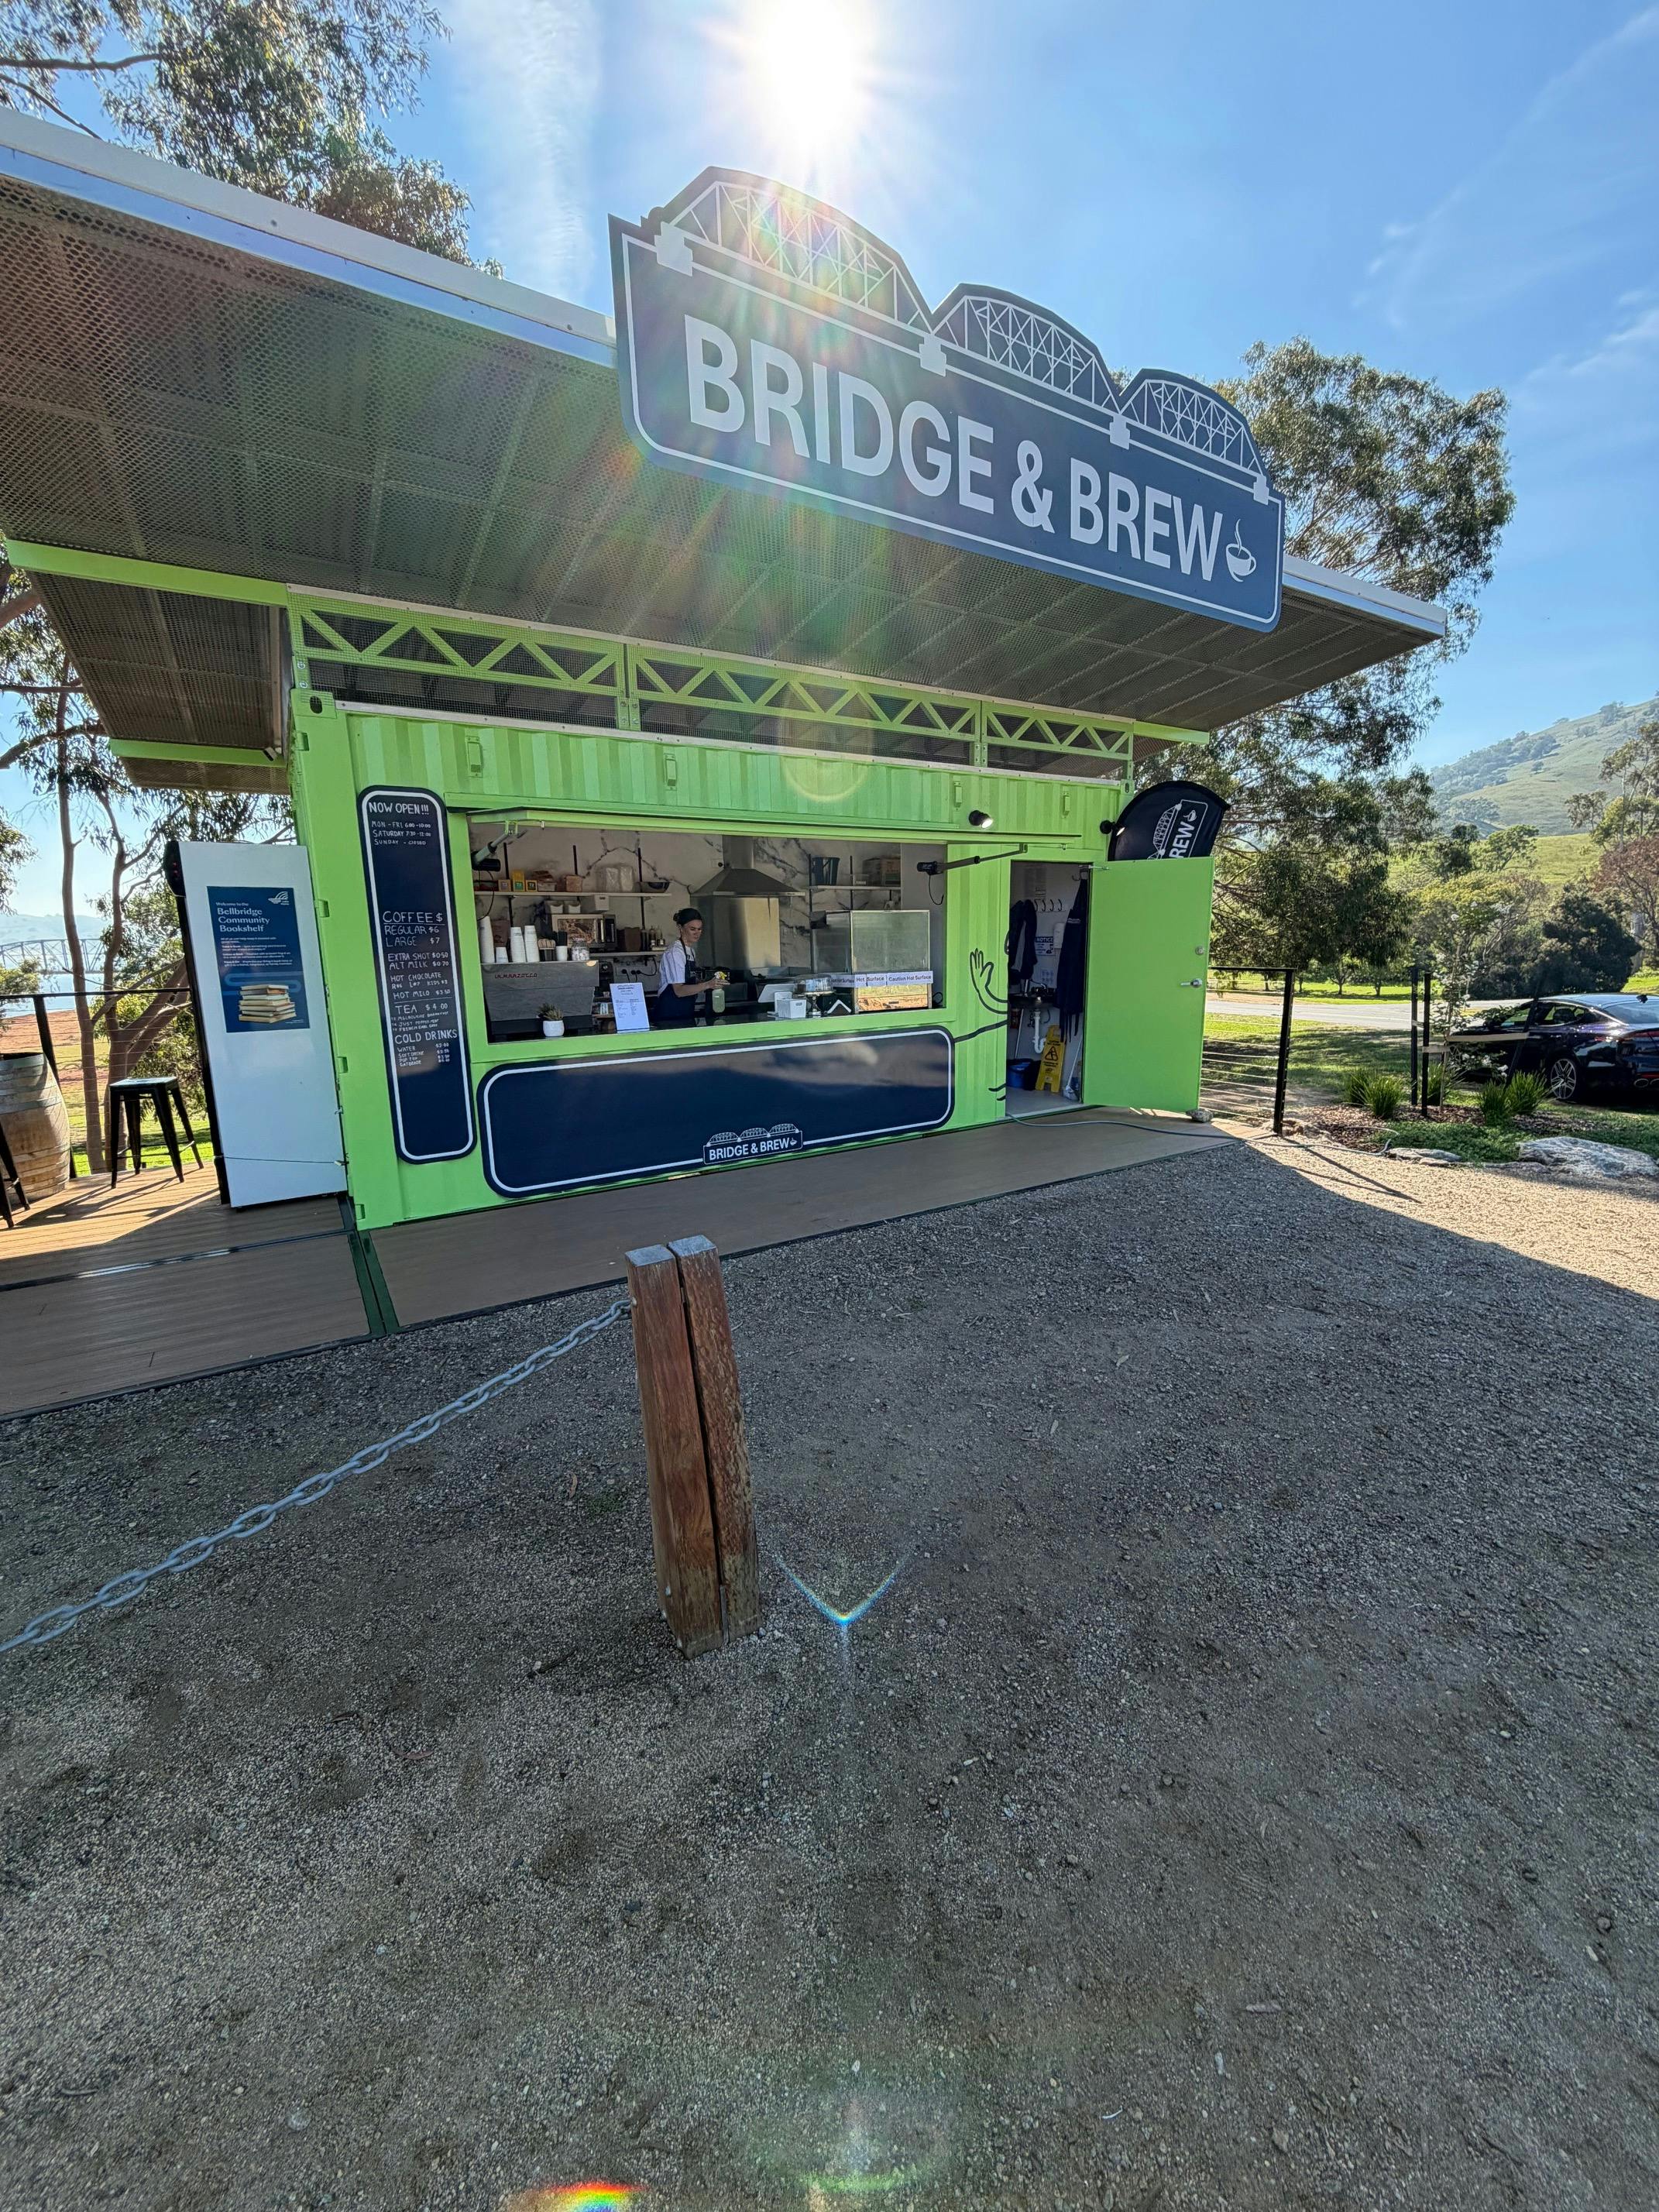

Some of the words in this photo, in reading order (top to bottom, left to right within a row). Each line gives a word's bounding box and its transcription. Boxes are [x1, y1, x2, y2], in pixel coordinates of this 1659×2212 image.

[684, 314, 994, 515] BRIDGE
[1011, 440, 1055, 534] &
[1070, 457, 1223, 581] BREW
[369, 802, 393, 813] NOW
[1169, 821, 1195, 858] REW
[217, 908, 263, 916] Bellbridge
[383, 911, 433, 922] COFFEE
[218, 916, 270, 925] Community
[384, 926, 427, 936] REGULAR
[386, 936, 417, 946] LARGE
[388, 953, 410, 961] EXTRA
[389, 961, 404, 970] ALT
[407, 960, 428, 969] MILK
[408, 972, 441, 981] CHOCOLATE
[393, 991, 409, 1000] HOT
[394, 1005, 417, 1015] TEA
[395, 1032, 421, 1044] COLD
[425, 1029, 458, 1041] DRINKS
[709, 1144, 749, 1161] BRIDGE
[750, 1142, 758, 1154] &
[760, 1137, 790, 1152] BREW
